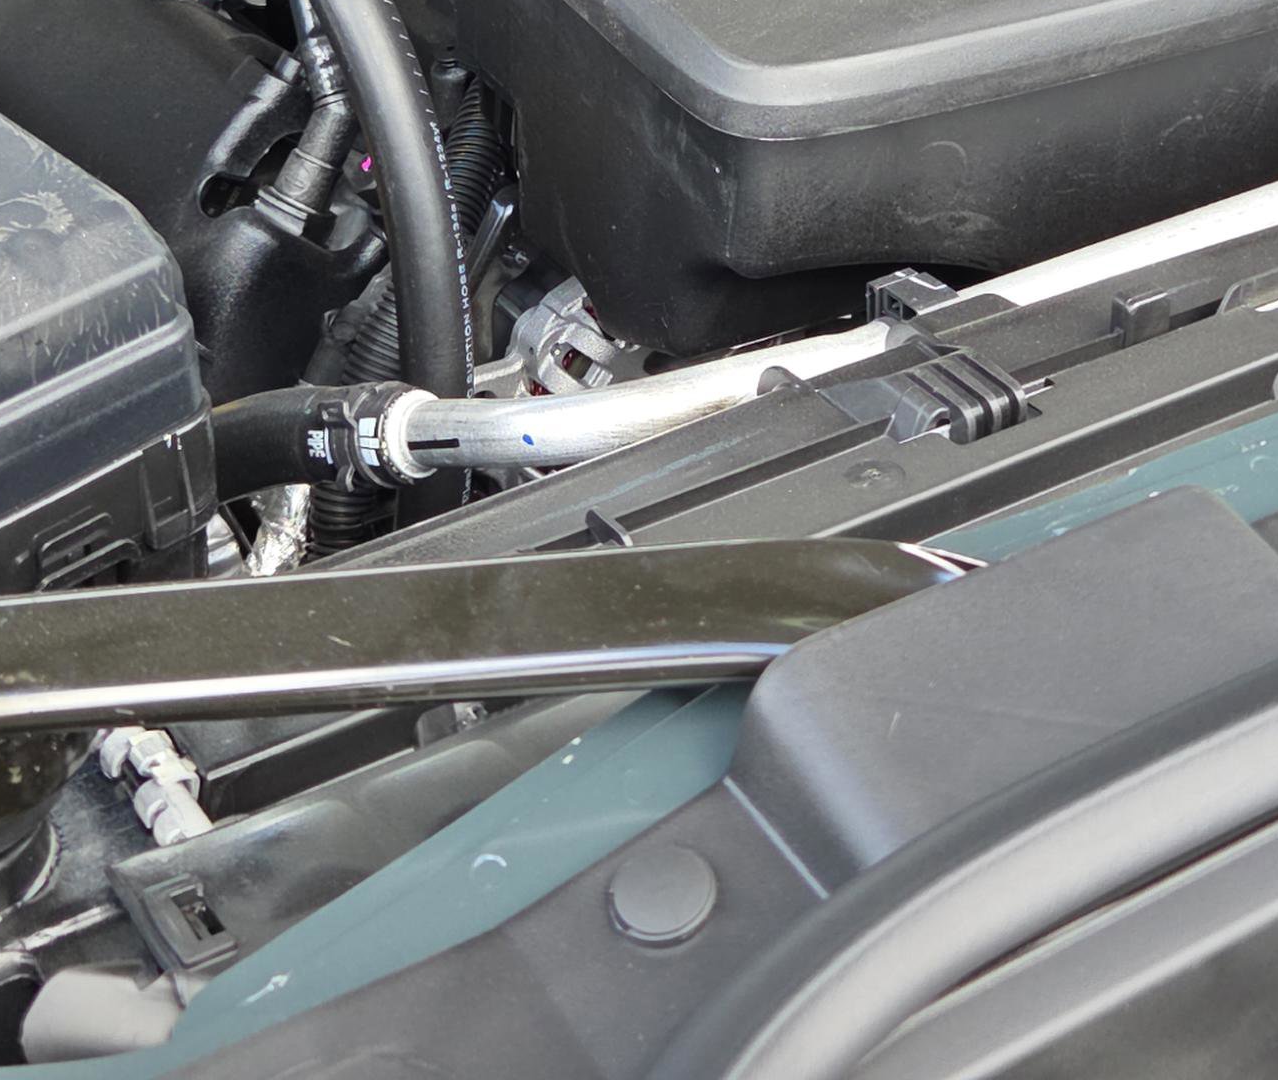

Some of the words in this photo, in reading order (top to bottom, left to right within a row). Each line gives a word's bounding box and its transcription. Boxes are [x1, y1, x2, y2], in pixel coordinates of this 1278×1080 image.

[458, 263, 470, 309] HOSE
[463, 313, 473, 384] SUCTION
[307, 430, 326, 458] PIPE
